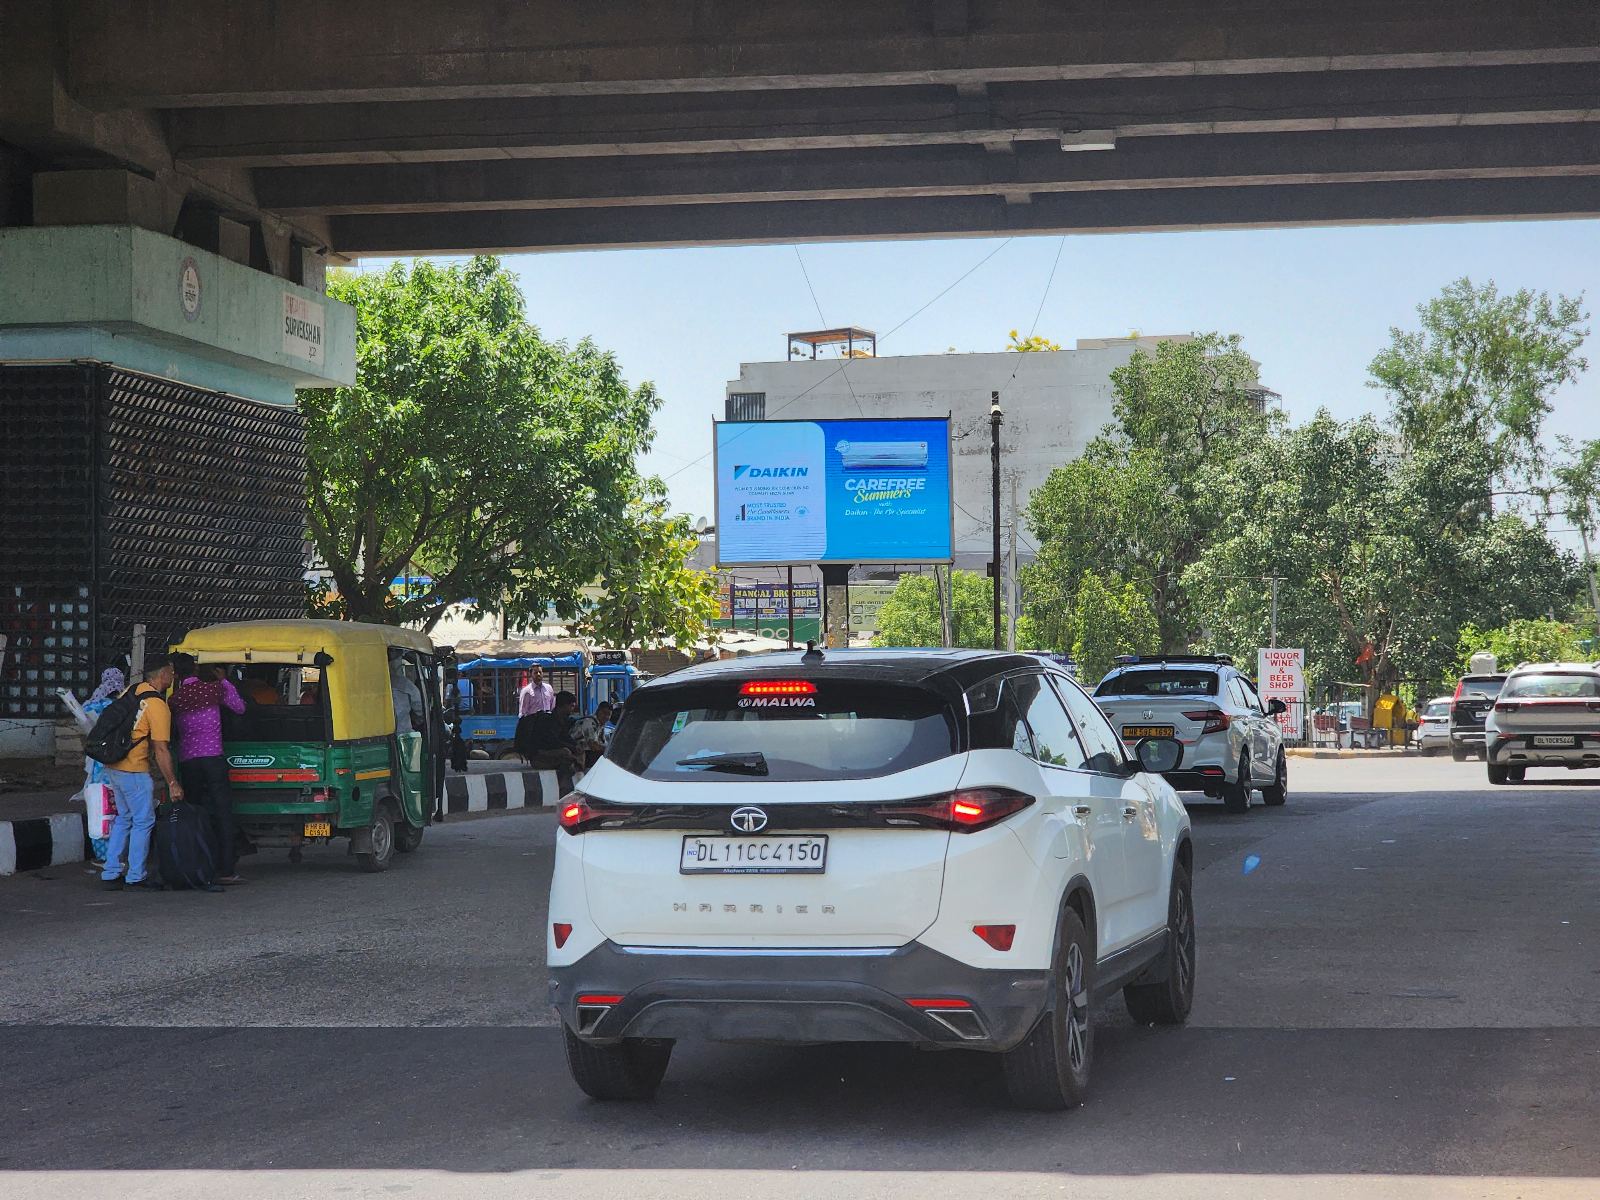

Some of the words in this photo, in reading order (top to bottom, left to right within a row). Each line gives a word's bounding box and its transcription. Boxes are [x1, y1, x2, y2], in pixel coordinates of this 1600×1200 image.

[286, 316, 320, 345] SURVEKSHAN
[749, 467, 809, 478] DAIKIN
[845, 478, 926, 491] CAREFREE
[854, 488, 911, 504] Summers
[1264, 652, 1300, 660] LIQUOR
[751, 697, 816, 707] MALWA
[673, 902, 836, 914] HARRIER
